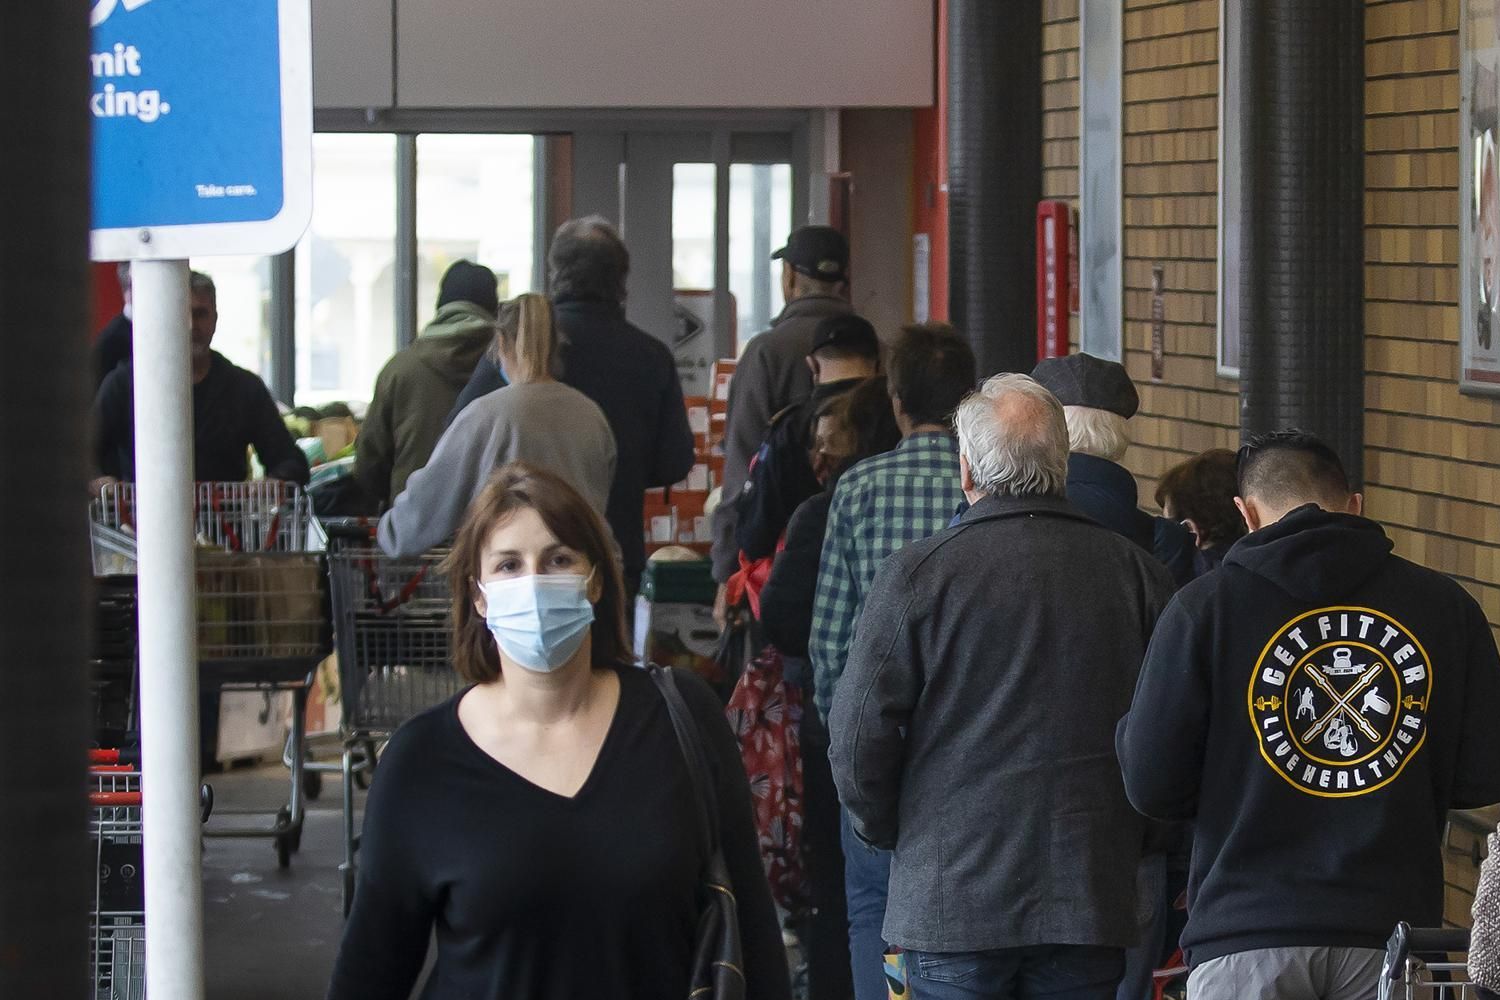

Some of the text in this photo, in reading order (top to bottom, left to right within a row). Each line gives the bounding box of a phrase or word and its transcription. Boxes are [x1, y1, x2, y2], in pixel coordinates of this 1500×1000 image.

[195, 184, 225, 198] Take
[1262, 614, 1425, 686] GET FITTER
[1263, 714, 1422, 788] LIVE HEALTHIER
